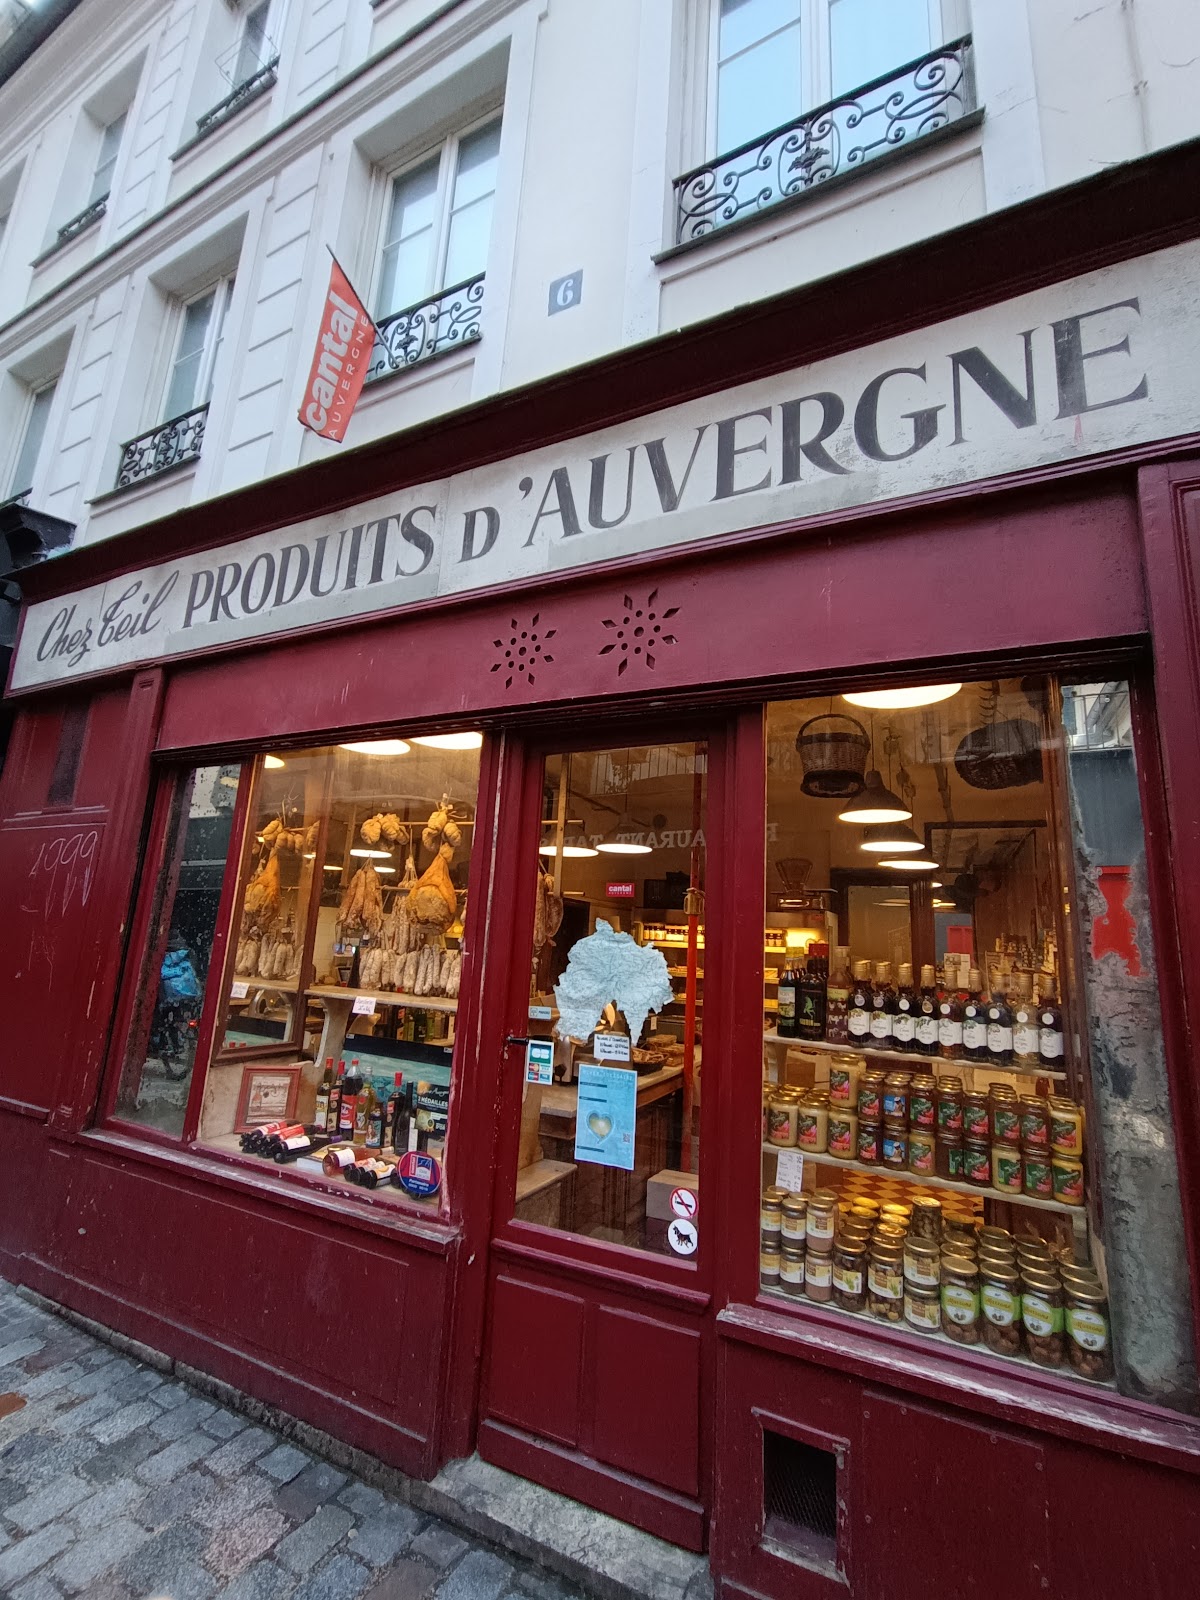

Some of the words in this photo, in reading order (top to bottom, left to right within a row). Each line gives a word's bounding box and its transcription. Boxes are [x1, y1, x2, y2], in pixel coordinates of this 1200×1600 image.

[556, 279, 574, 306] 6
[306, 291, 358, 431] cantal
[309, 315, 369, 439] AUVERGNE
[37, 604, 93, 668] Chez
[182, 504, 437, 629] PRODUITS
[608, 884, 632, 892] cantal
